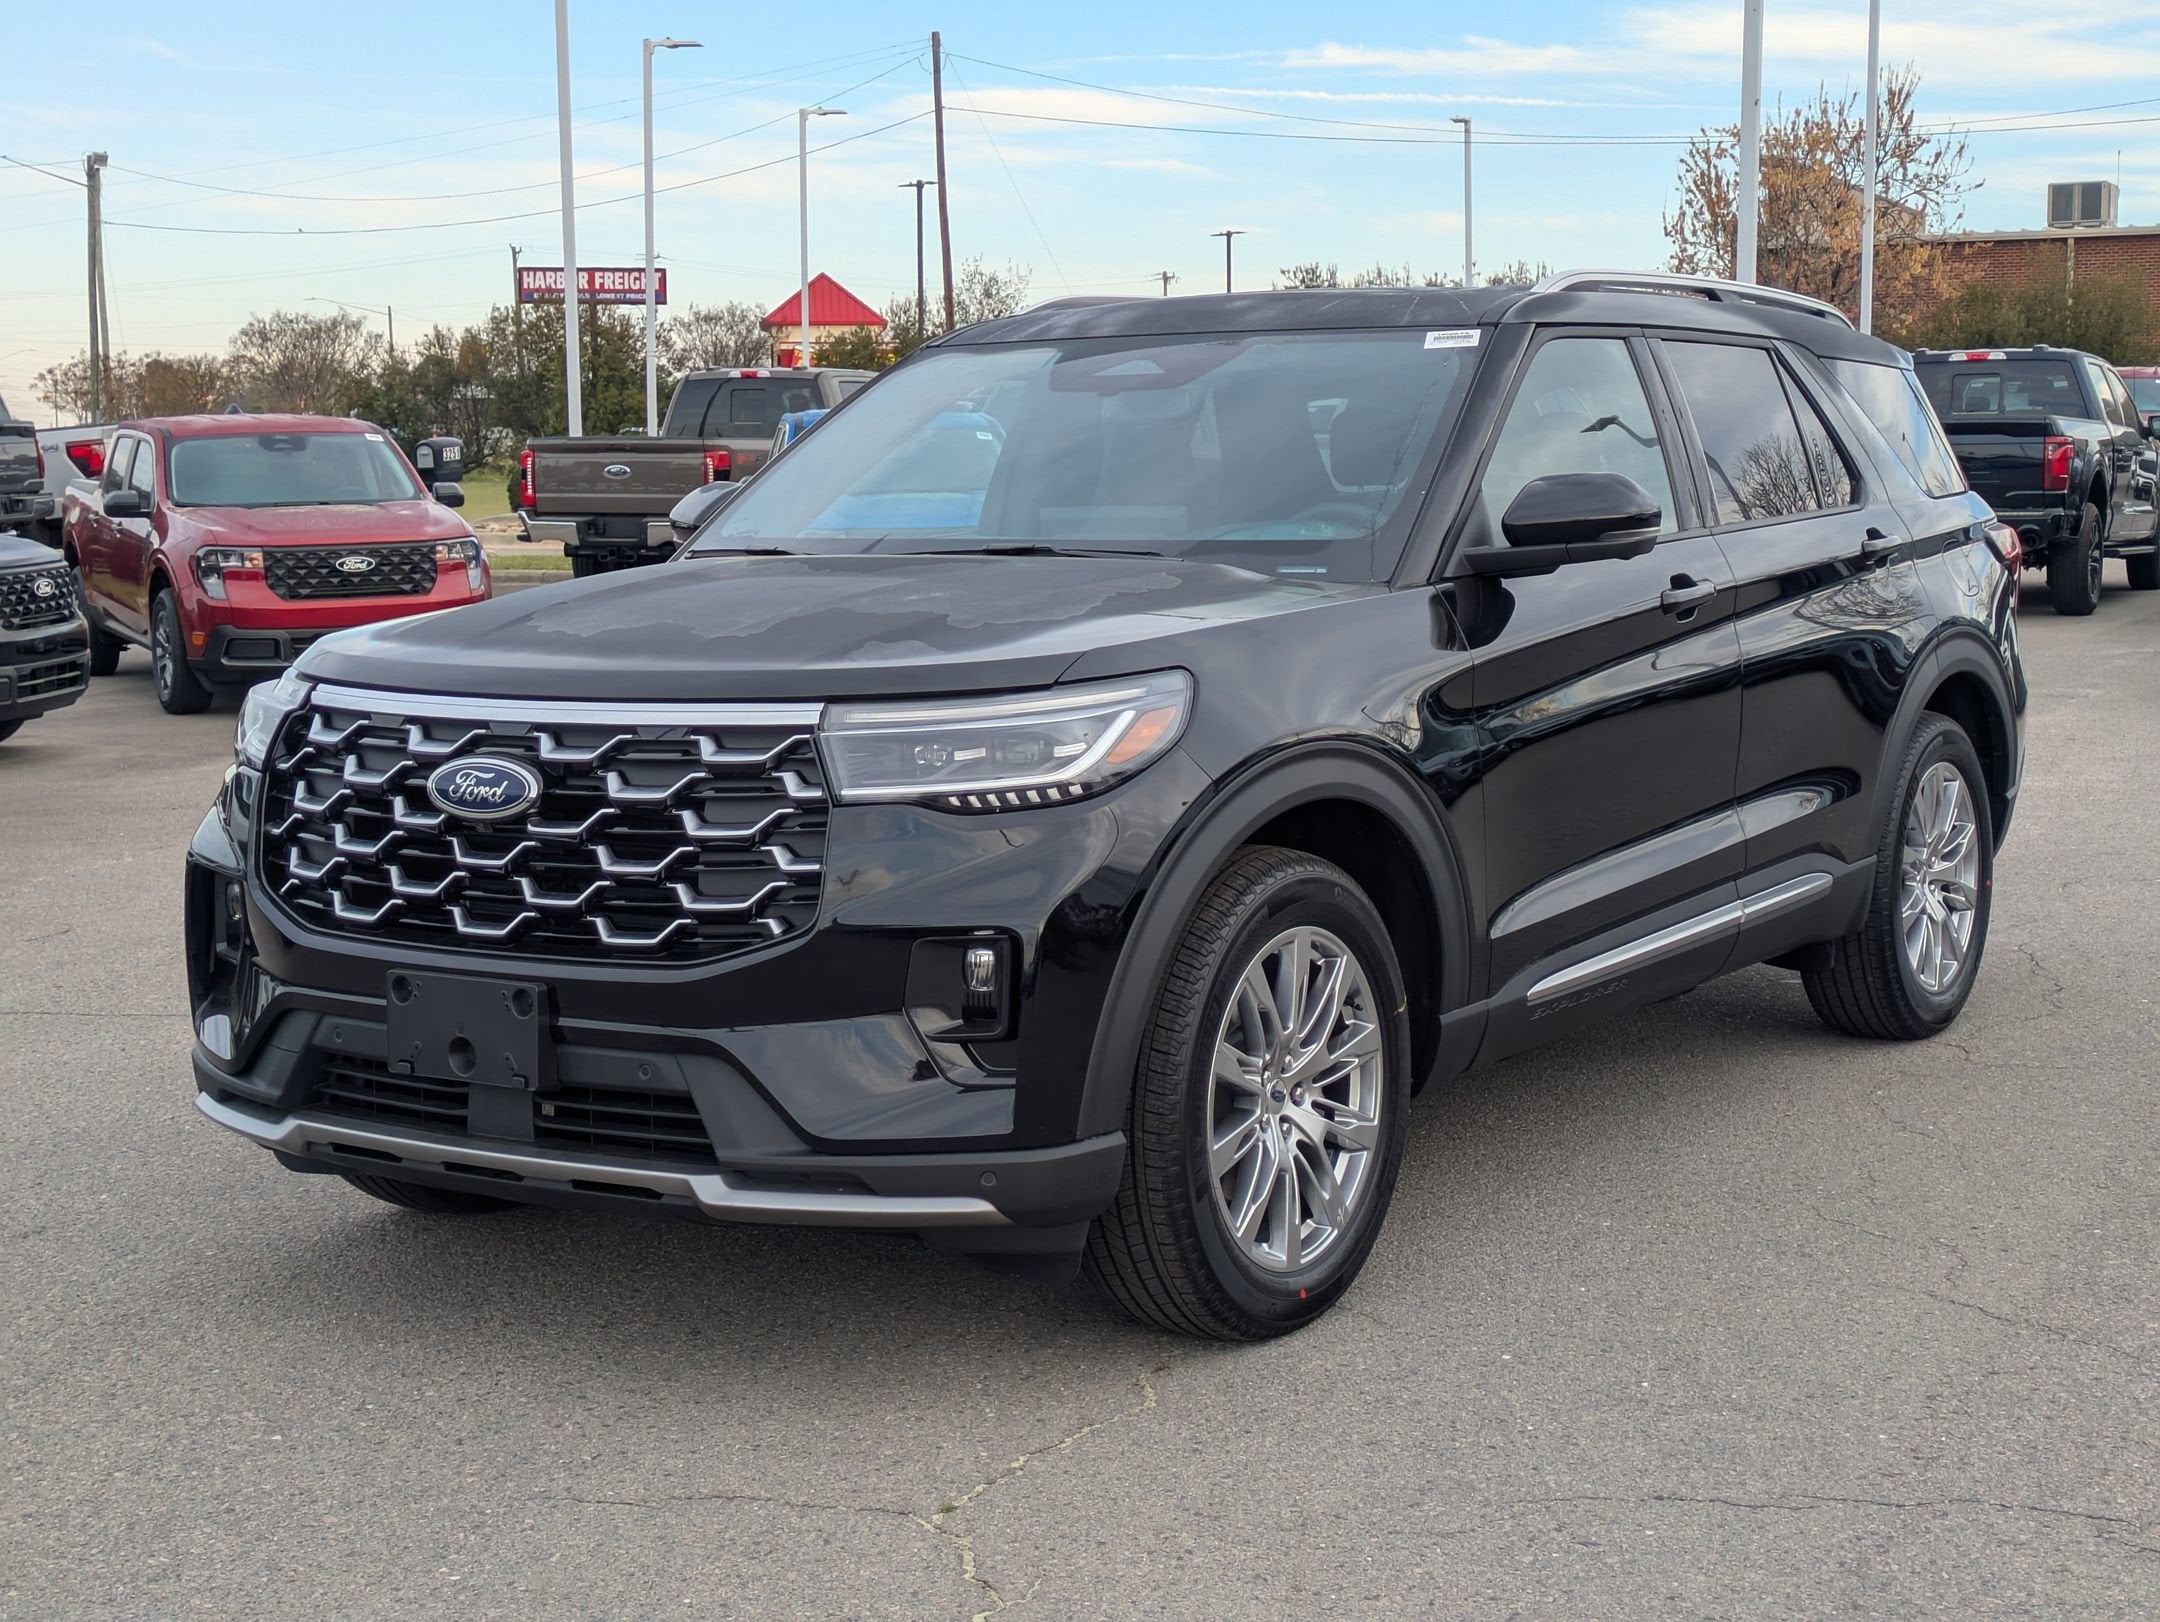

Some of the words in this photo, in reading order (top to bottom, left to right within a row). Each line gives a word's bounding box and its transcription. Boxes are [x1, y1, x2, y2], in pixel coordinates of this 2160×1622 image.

[523, 271, 590, 290] HARBR
[443, 447, 460, 461] 3251
[343, 559, 368, 570] Ford
[449, 769, 509, 803] Ford
